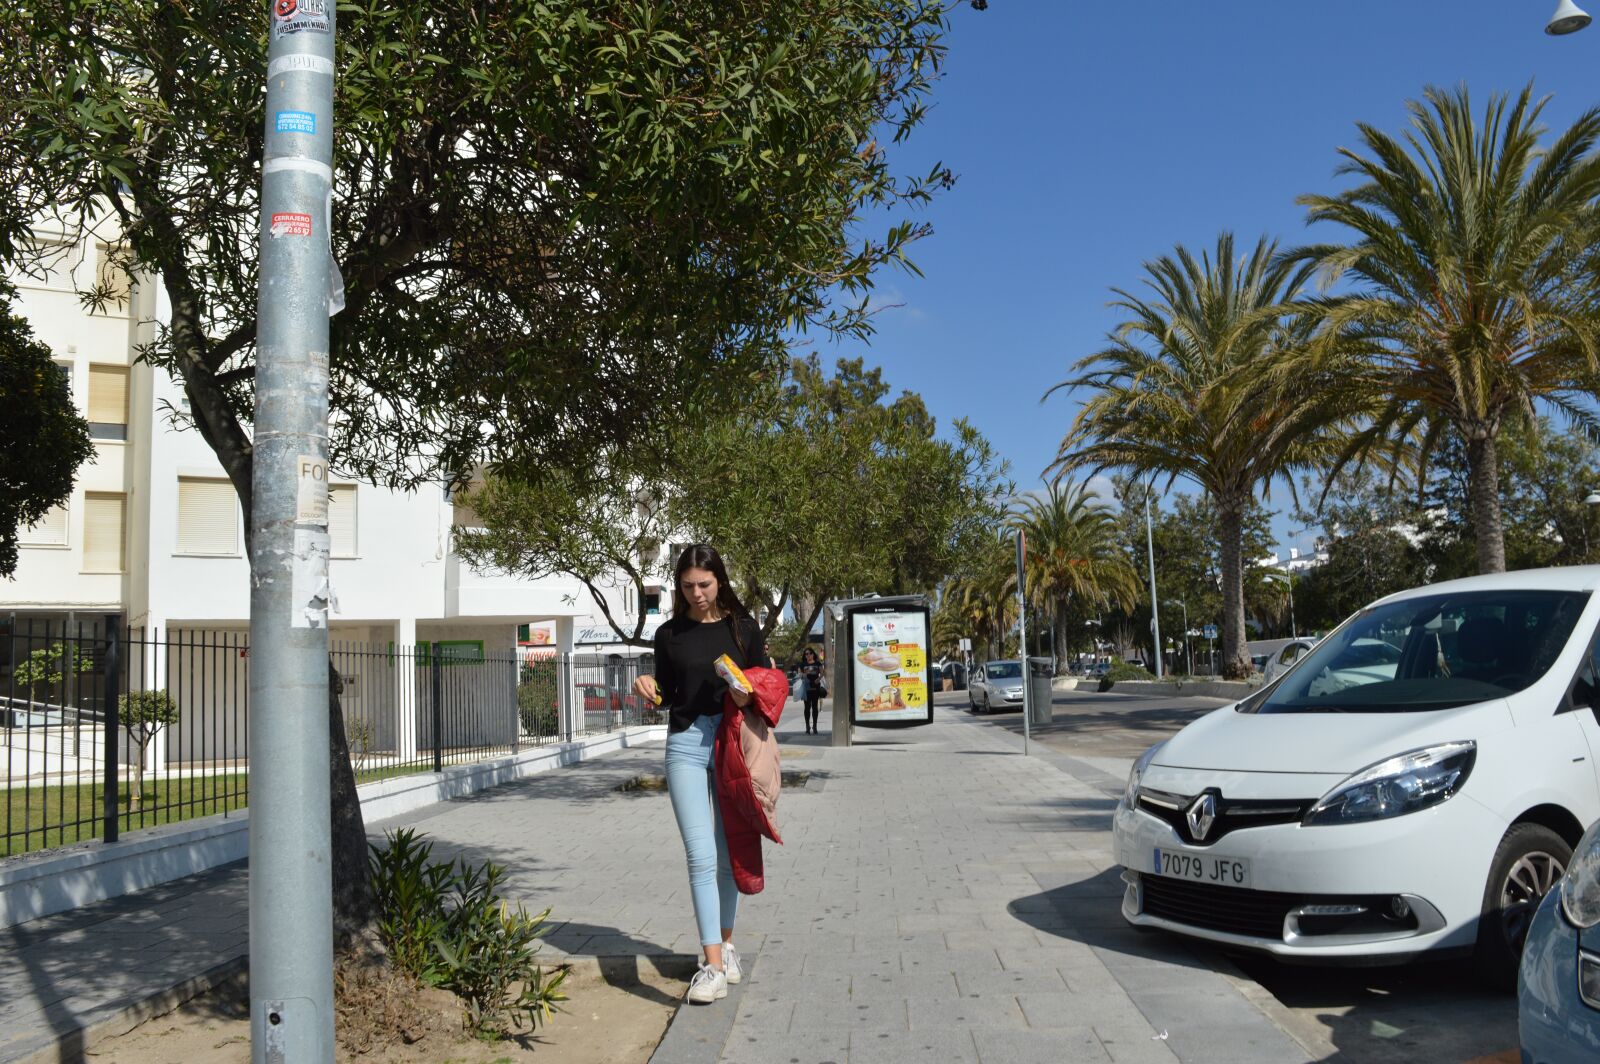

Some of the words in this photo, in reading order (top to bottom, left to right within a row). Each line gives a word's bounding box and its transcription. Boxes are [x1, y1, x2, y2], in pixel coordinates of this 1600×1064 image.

[274, 215, 310, 223] CERRAJERO
[580, 629, 609, 639] Mora
[1163, 853, 1203, 878] 7079
[1209, 860, 1244, 883] JFG
